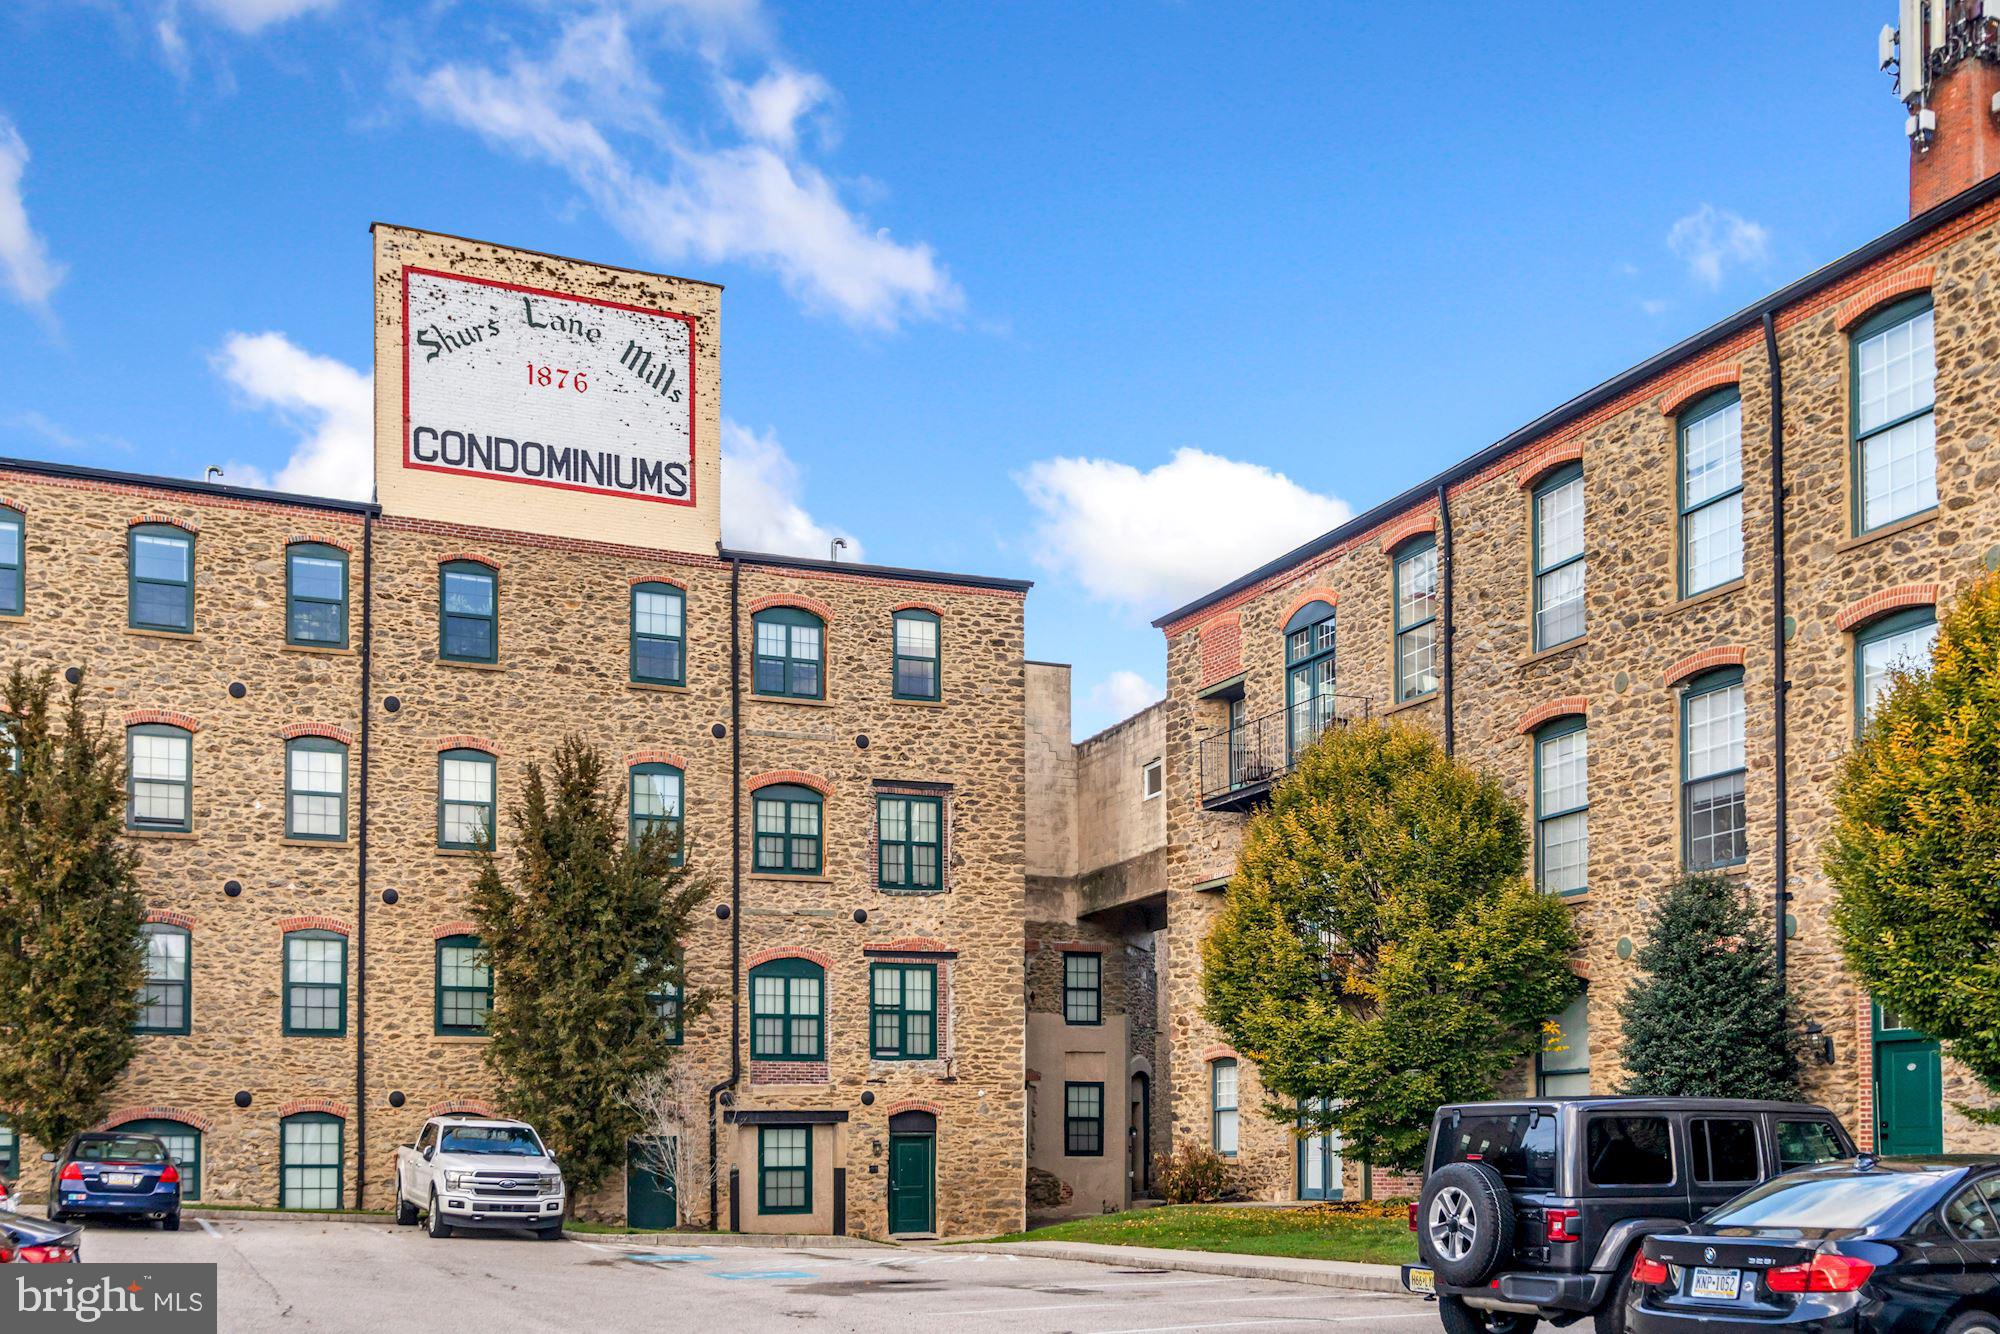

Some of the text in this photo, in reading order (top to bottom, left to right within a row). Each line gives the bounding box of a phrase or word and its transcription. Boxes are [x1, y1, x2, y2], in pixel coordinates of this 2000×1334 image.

[416, 296, 682, 403] Shurs Lane Mills
[526, 364, 588, 393] 1876
[413, 426, 688, 496] CONDOMINIUMS
